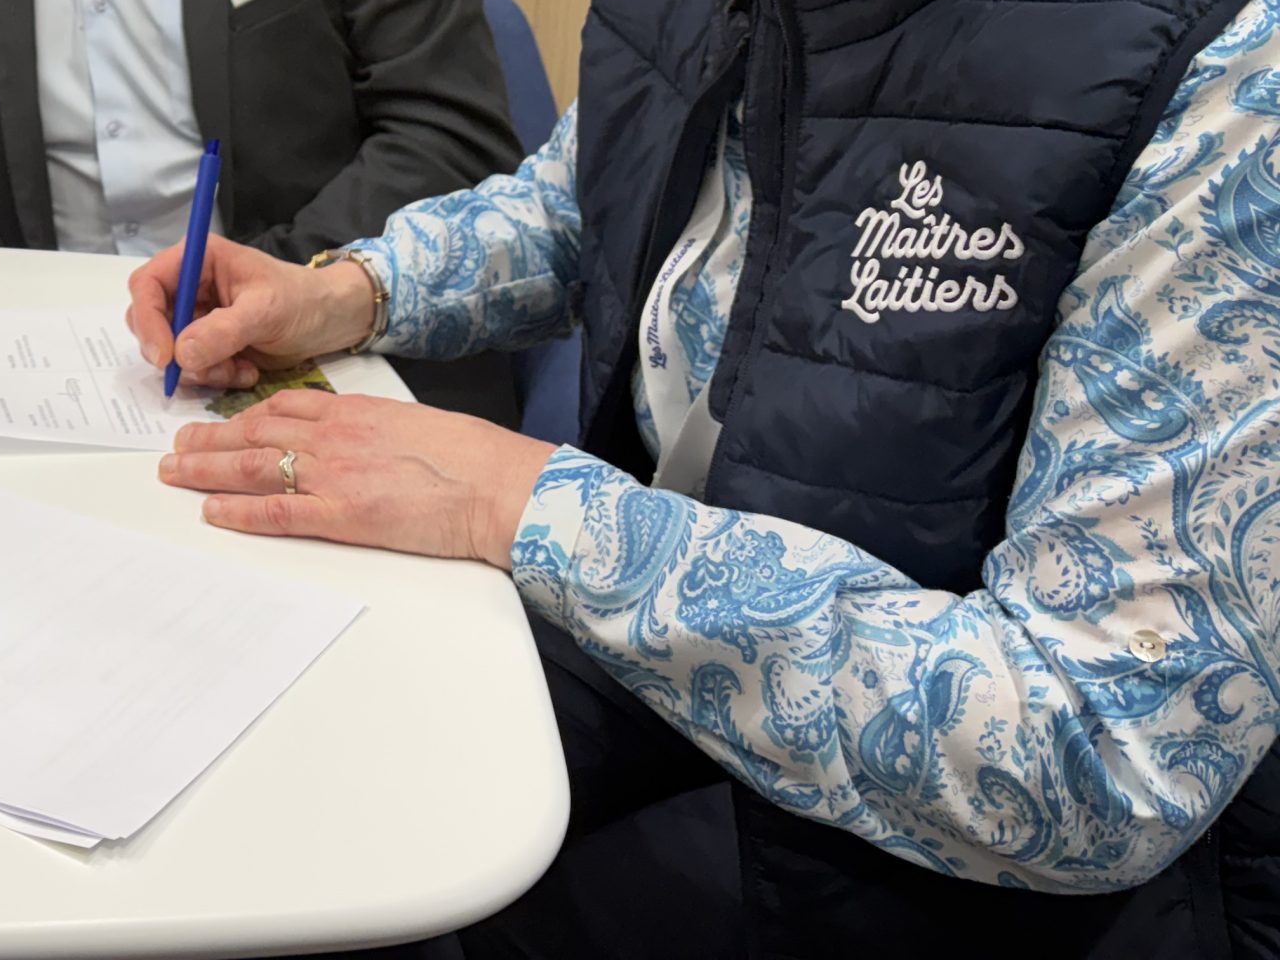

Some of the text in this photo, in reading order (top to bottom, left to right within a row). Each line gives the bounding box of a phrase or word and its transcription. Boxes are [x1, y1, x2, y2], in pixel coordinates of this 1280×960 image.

[890, 159, 944, 220] Les
[850, 206, 1026, 261] Maîtres
[840, 257, 1019, 324] Laitiers
[648, 344, 668, 370] Les
